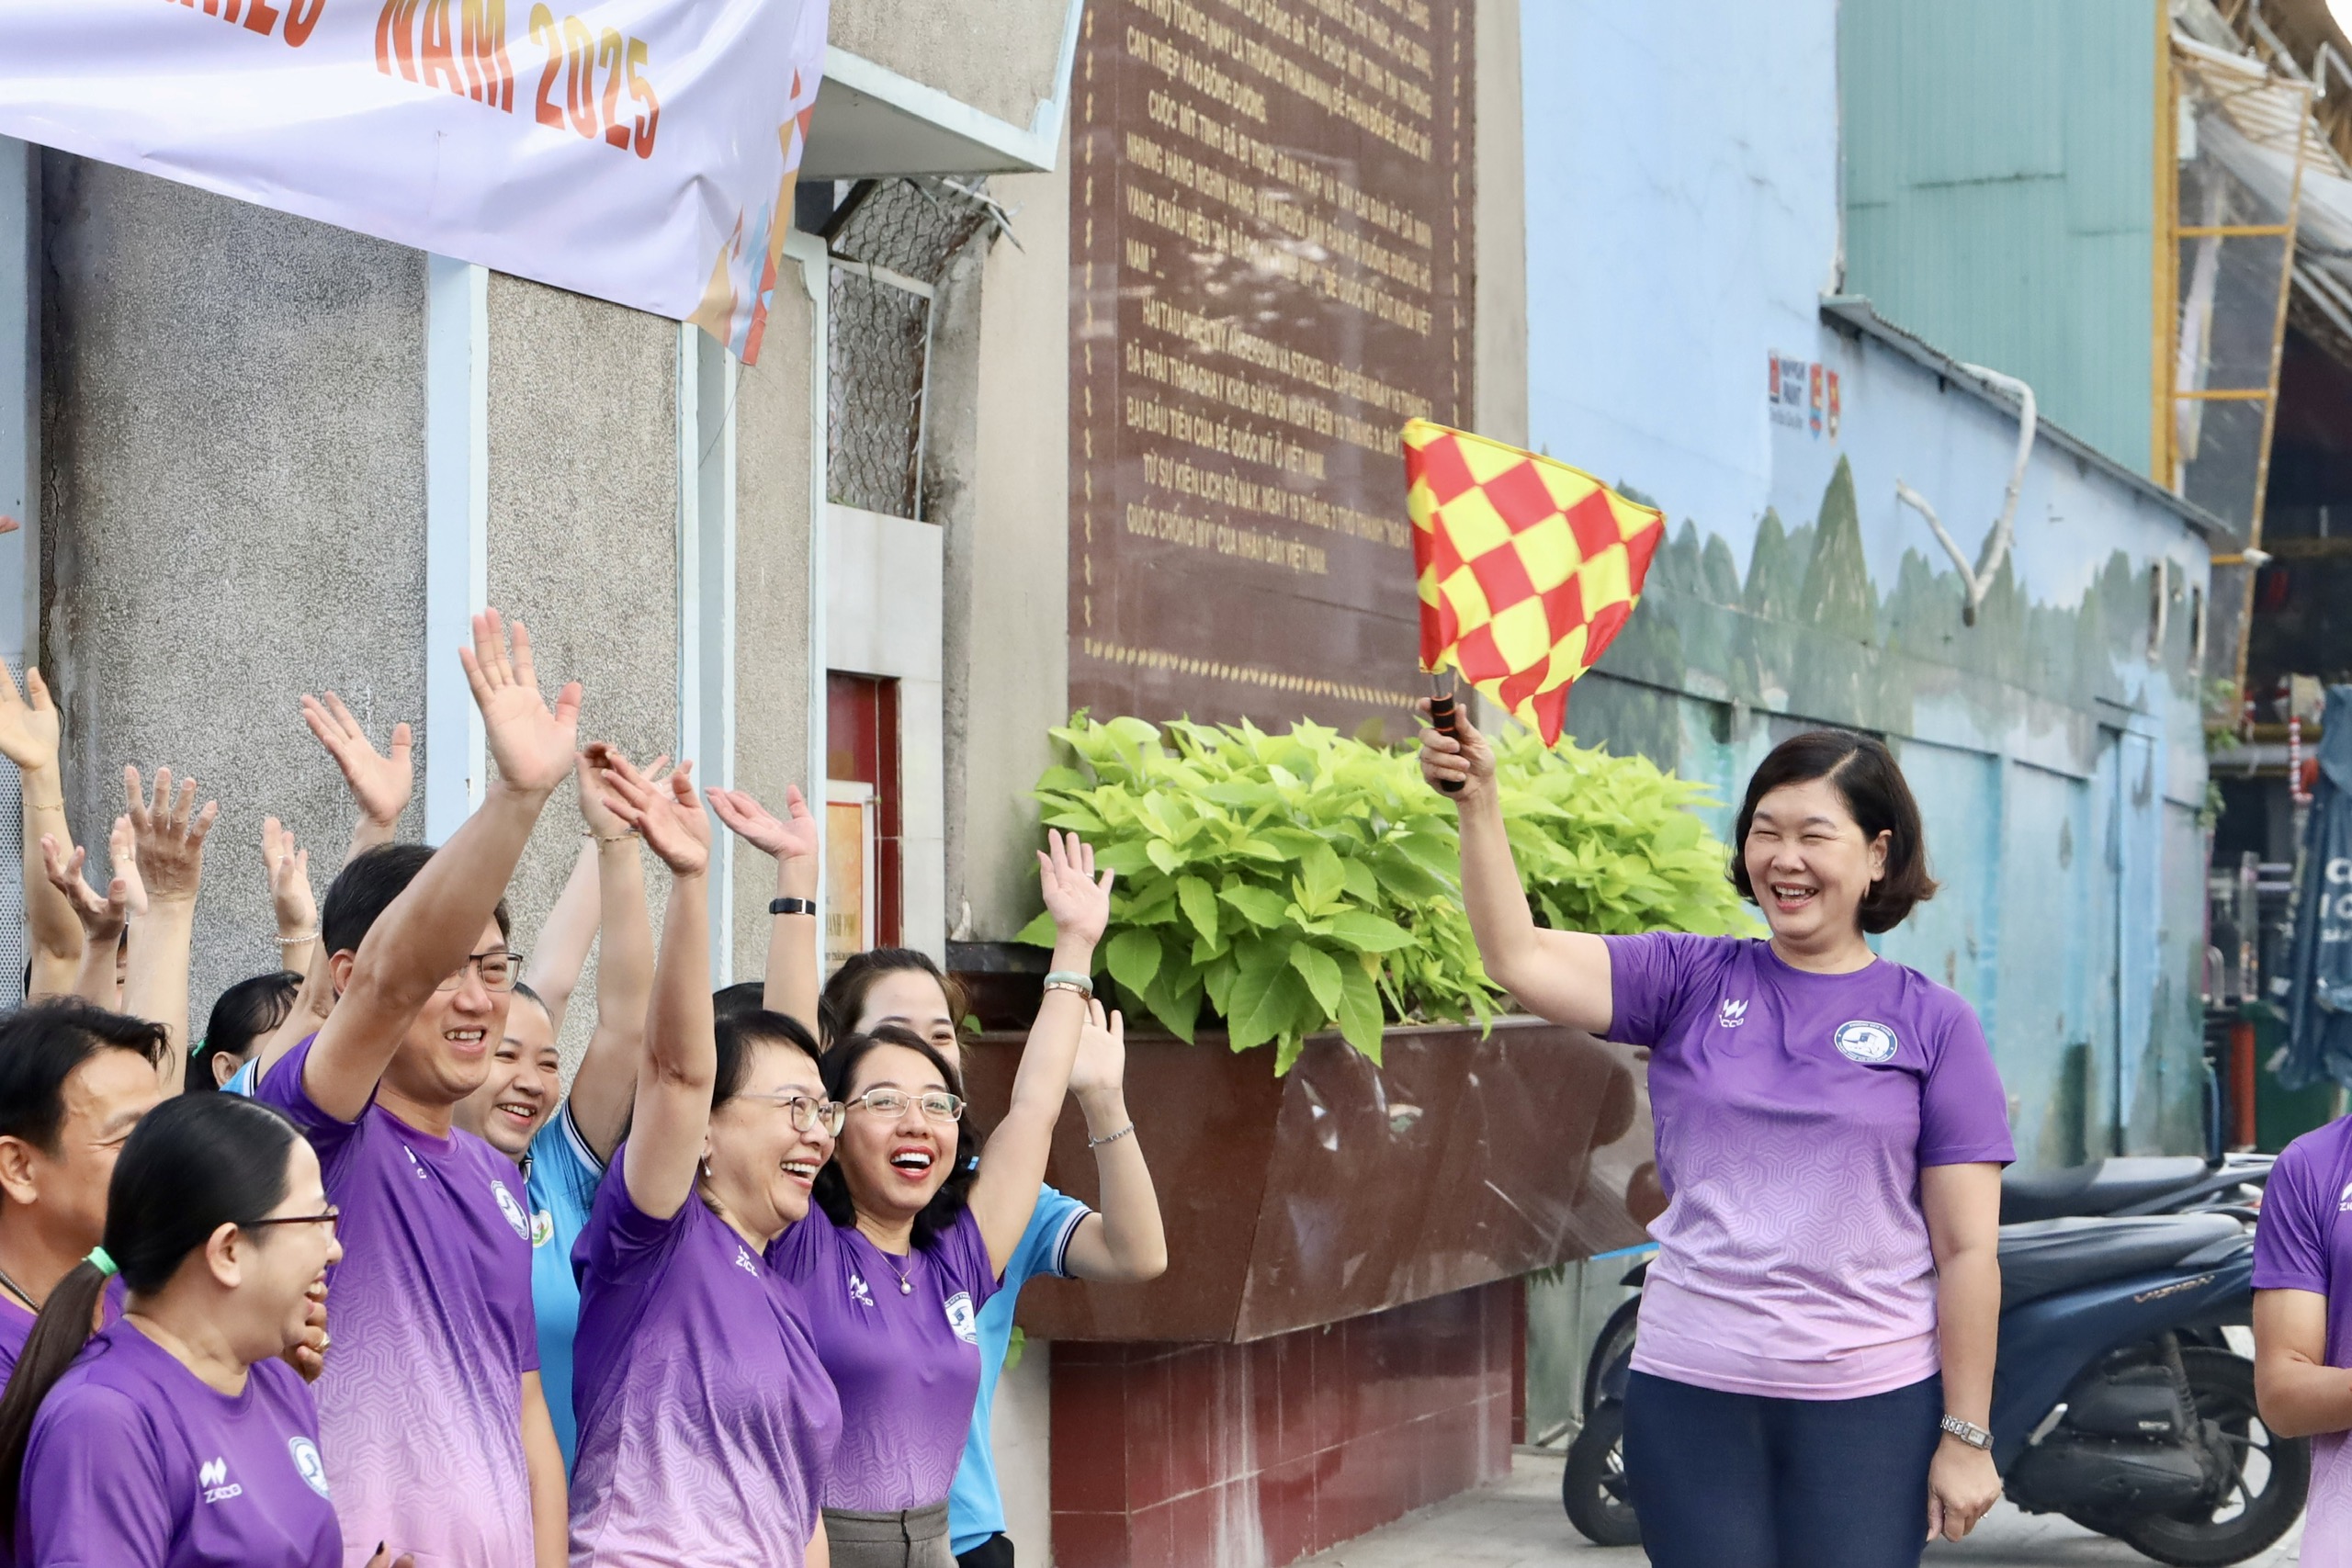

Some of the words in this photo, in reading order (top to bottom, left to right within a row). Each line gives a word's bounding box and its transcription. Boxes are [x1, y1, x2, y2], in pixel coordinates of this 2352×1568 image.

[529, 3, 660, 159] 2025
[1148, 36, 1180, 80] THIỆP
[1204, 63, 1231, 105] ĐÔNG
[1148, 87, 1178, 130] CUỘC
[1198, 112, 1221, 149] TINH
[1222, 122, 1237, 156] ĐÃ
[1296, 160, 1322, 197] PHÁP
[1164, 146, 1194, 187] HÀNG
[1125, 185, 1156, 222] VANG
[1156, 193, 1185, 234] KHẨU
[1185, 209, 1210, 247] HIỆU
[1125, 237, 1149, 271] NAM
[1125, 339, 1141, 373] ĐÃ
[1142, 346, 1168, 382] PHẢI
[1226, 374, 1250, 408] KHỎI
[1250, 380, 1266, 413] SÀI
[1142, 295, 1160, 328] HAI
[1160, 299, 1182, 335] TÀU
[1290, 350, 1332, 388] STICKELL
[1125, 395, 1145, 430] BẠI
[1145, 392, 1168, 433] ĐẦU
[1168, 405, 1193, 440] TIÊN
[1193, 412, 1215, 446] CỦA
[1215, 413, 1229, 450] ĐẾ
[1230, 421, 1260, 458] QUỐC
[1259, 432, 1273, 463] MỸ
[1142, 448, 1158, 482] TỪ
[1158, 457, 1173, 492] SỰ
[1174, 458, 1199, 497] KIỆN
[1199, 468, 1223, 502] LỊCH
[1223, 471, 1238, 503] SỬ
[1125, 493, 1156, 535] QUỐC
[1157, 502, 1194, 543] CHỐNG
[1216, 519, 1237, 553] CỦA
